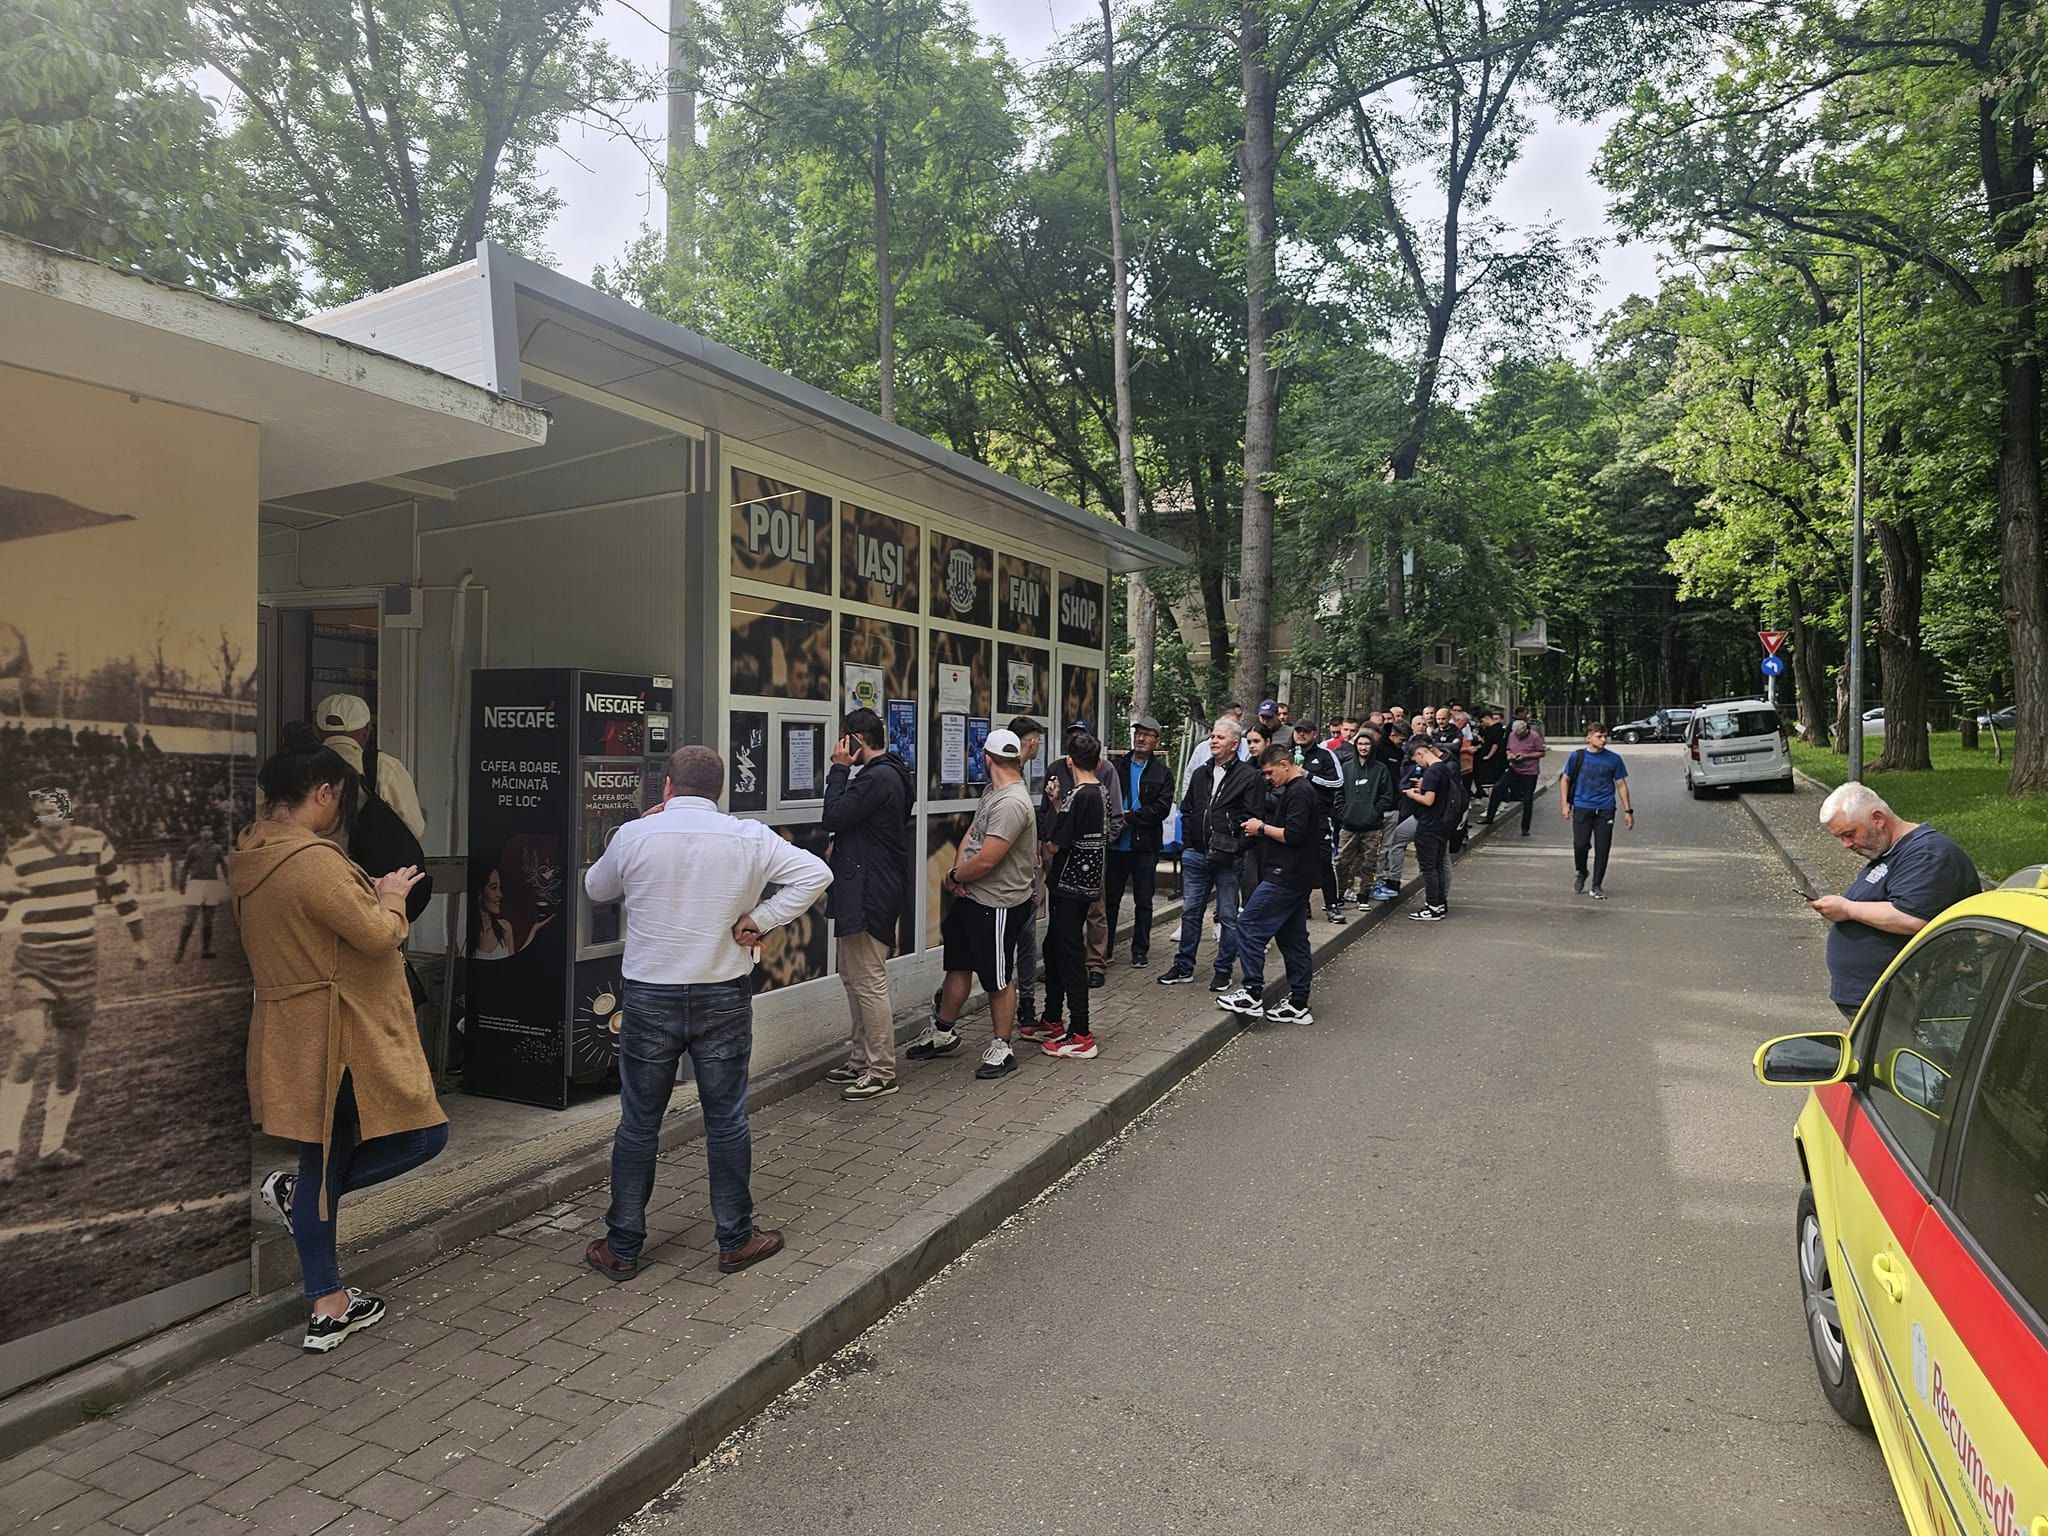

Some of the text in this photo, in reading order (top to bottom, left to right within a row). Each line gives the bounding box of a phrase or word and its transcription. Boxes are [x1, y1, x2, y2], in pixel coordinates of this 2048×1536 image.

[749, 503, 1097, 631] POLI IAȘI FAN SHOP
[480, 760, 561, 775] CAFEA BOABE,
[491, 775, 549, 791] MĂCINATĂ
[498, 794, 513, 806] PE
[592, 793, 616, 801] CAFEA
[1932, 1360, 2023, 1536] Recumedi
